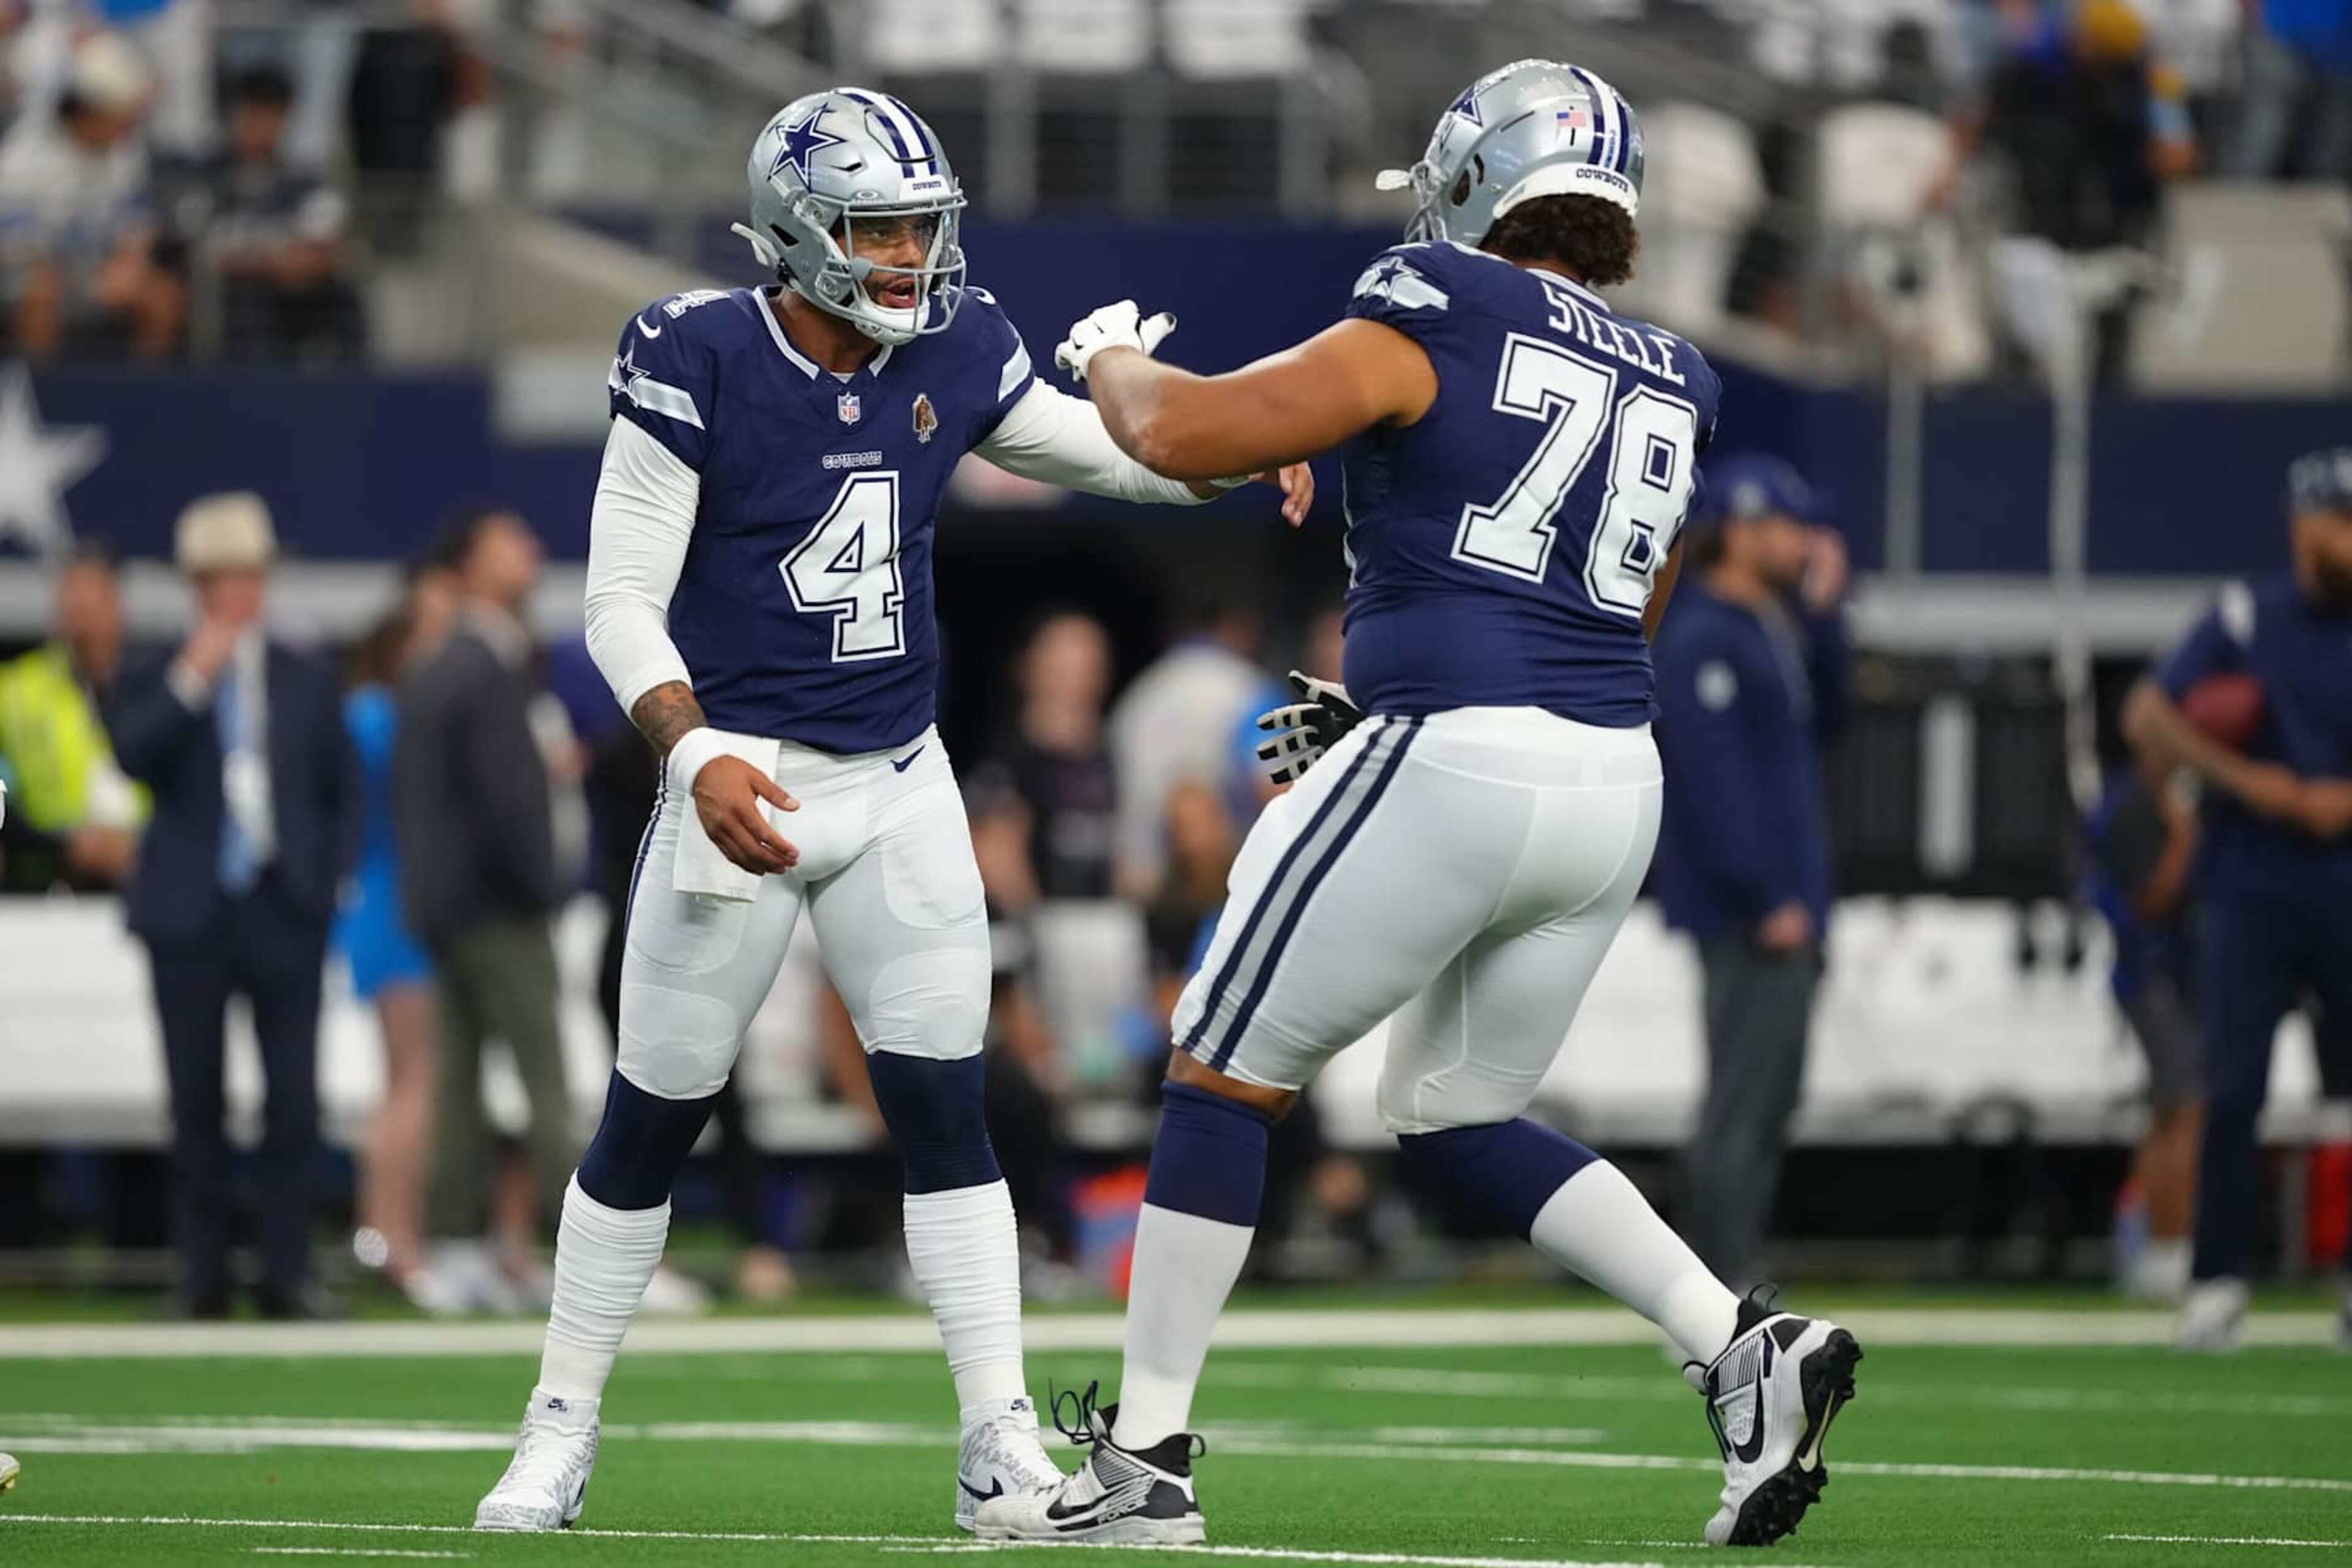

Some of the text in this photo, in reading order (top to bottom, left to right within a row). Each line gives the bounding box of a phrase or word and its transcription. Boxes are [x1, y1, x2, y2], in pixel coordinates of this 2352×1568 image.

[1576, 168, 1629, 193] COWBOYS
[1540, 281, 1685, 387] STEELE
[822, 451, 882, 469] COWBOYS
[1450, 331, 1697, 618] 78
[778, 470, 906, 663] 4
